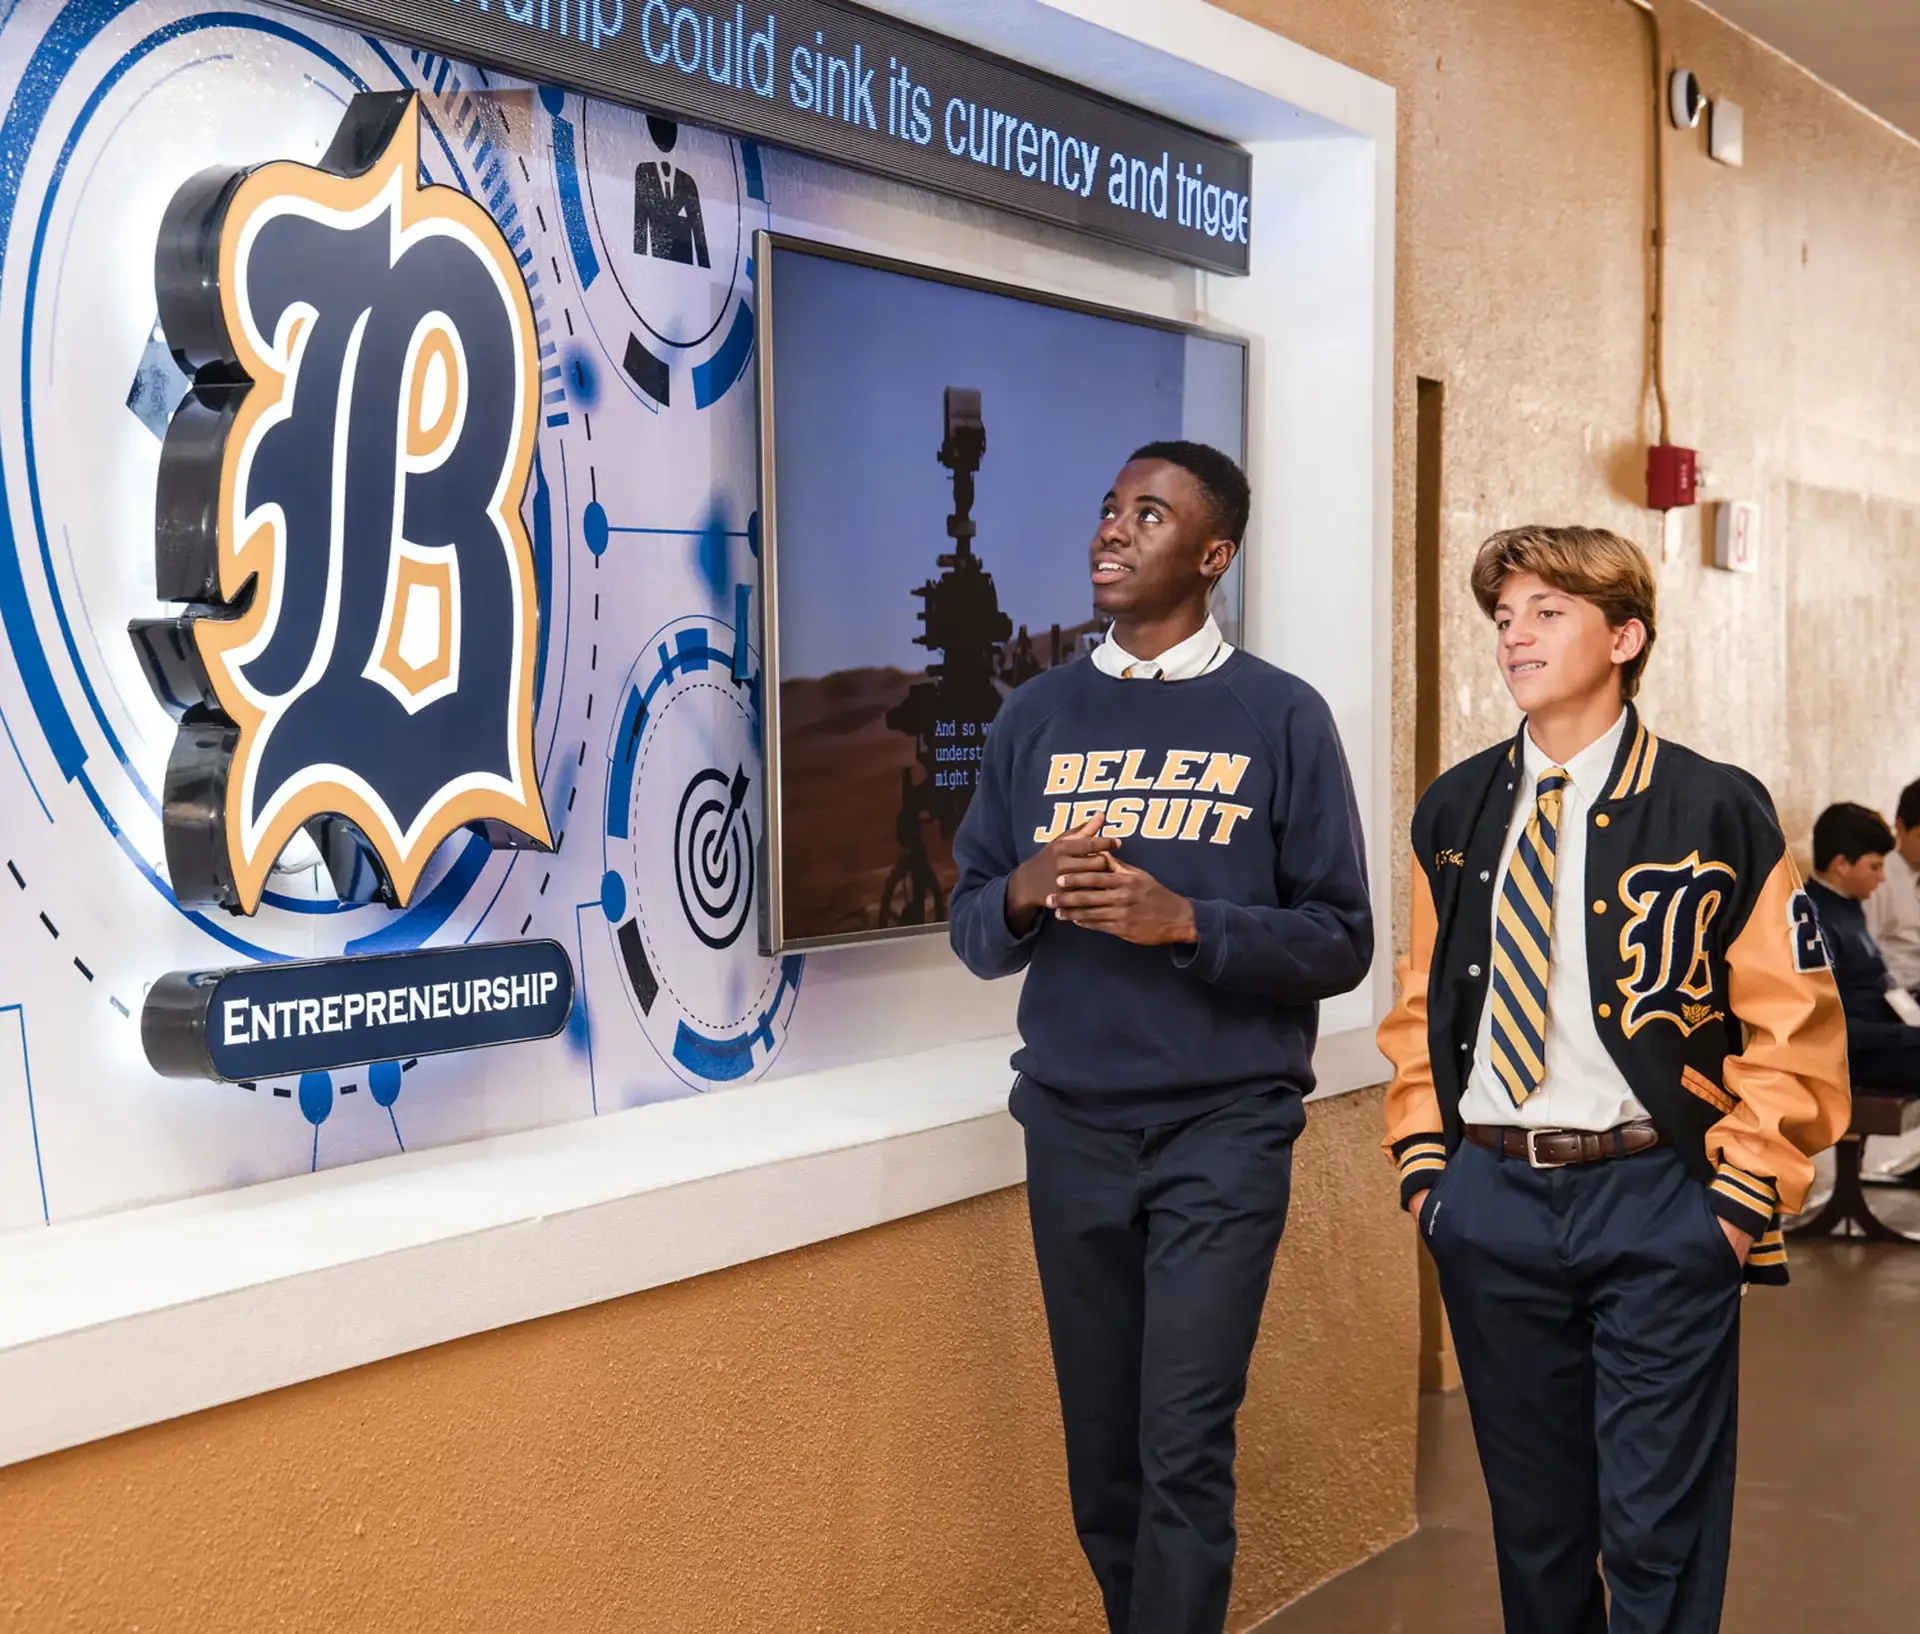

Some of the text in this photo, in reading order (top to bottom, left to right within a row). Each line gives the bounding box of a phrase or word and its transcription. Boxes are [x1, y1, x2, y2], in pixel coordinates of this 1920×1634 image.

[641, 0, 776, 98] could
[790, 31, 878, 130] sink
[888, 56, 932, 146] its
[944, 97, 1100, 197] currency
[1108, 151, 1168, 220] and
[935, 719, 956, 737] And
[962, 722, 976, 736] so
[935, 769, 969, 791] might
[1043, 749, 1251, 796] BELEN
[222, 971, 559, 1046] ENTREPRENEURSHIP
